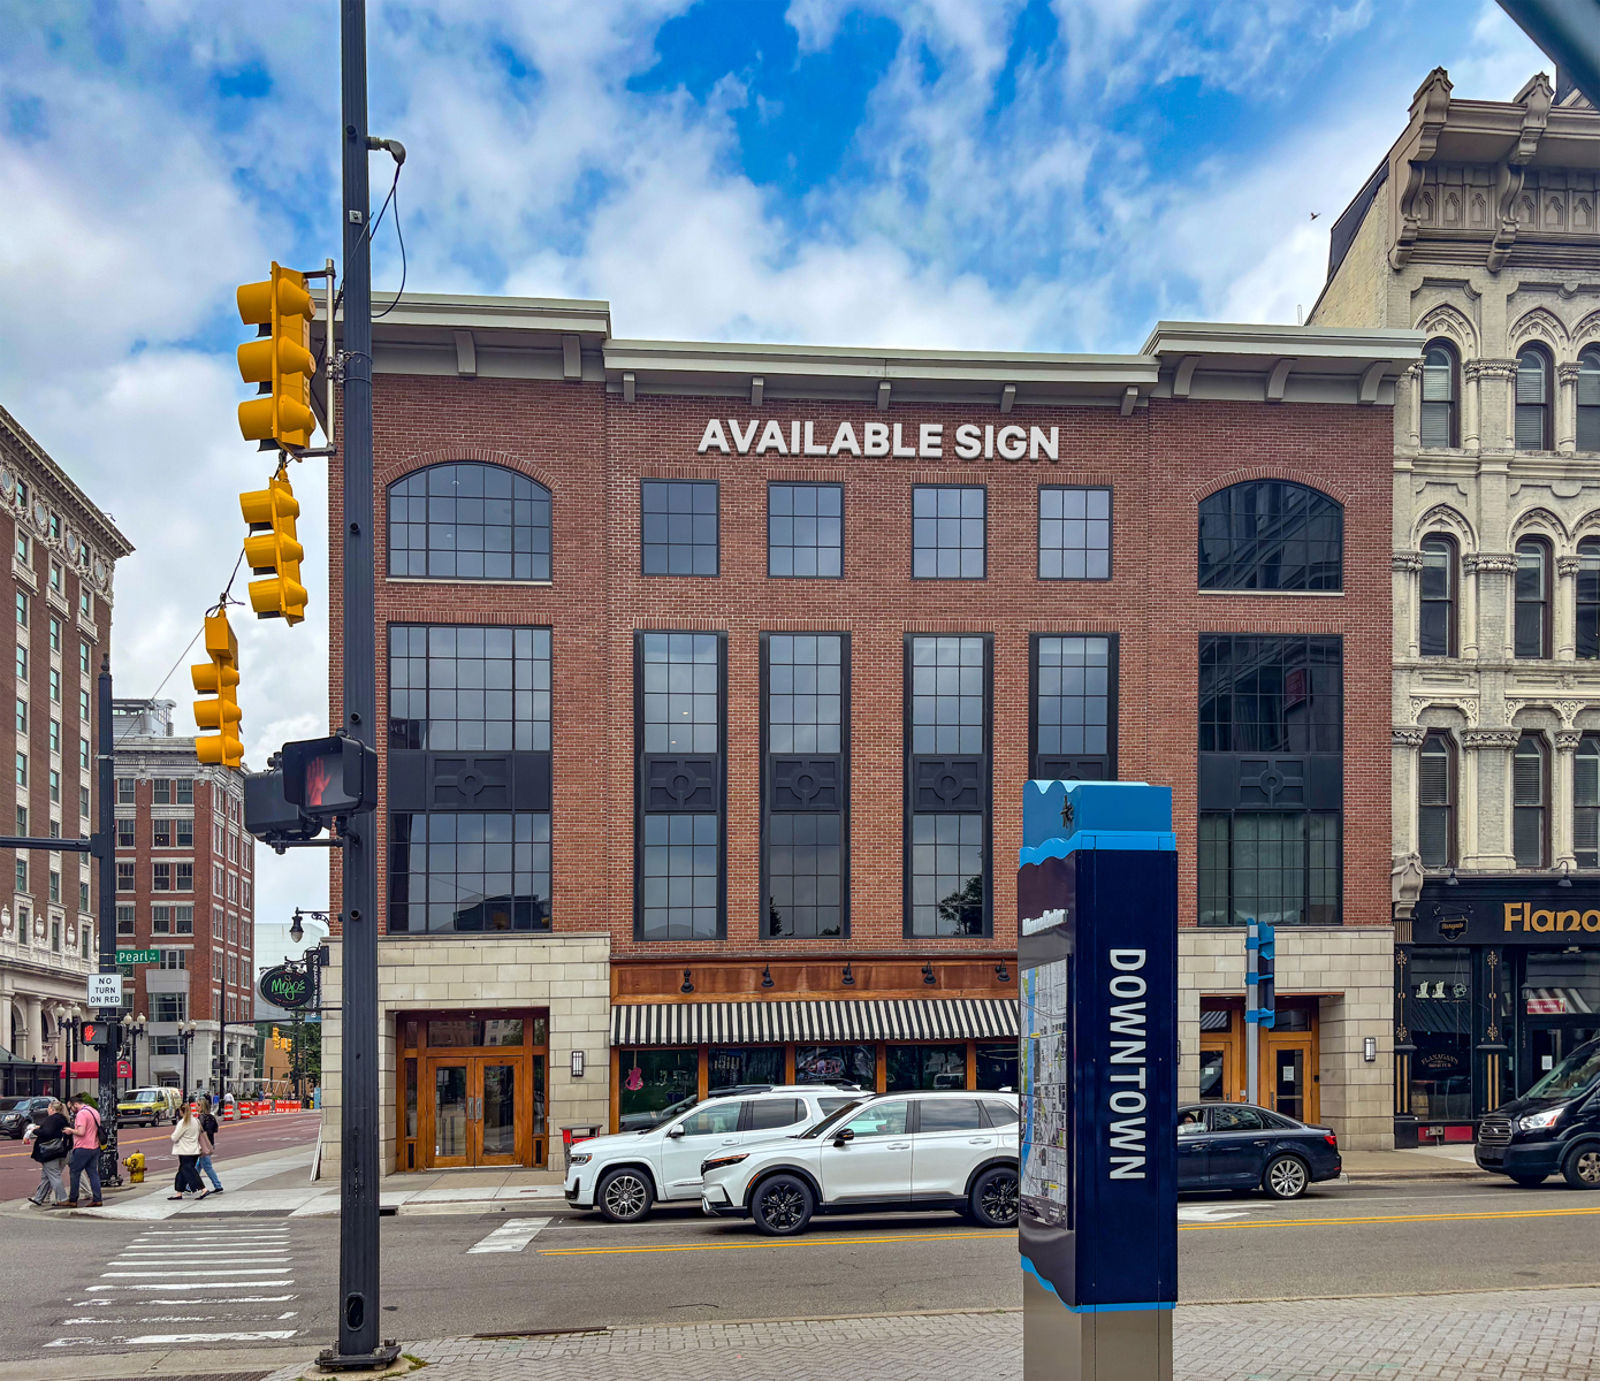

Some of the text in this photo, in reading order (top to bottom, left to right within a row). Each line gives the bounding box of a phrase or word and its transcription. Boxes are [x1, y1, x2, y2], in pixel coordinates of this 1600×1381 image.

[697, 418, 1060, 461] AVAILABLE SIGN
[119, 951, 148, 962] Pearl
[98, 977, 112, 985] NO
[104, 996, 120, 1004] RED
[1109, 949, 1147, 1180] DOWNTOWN
